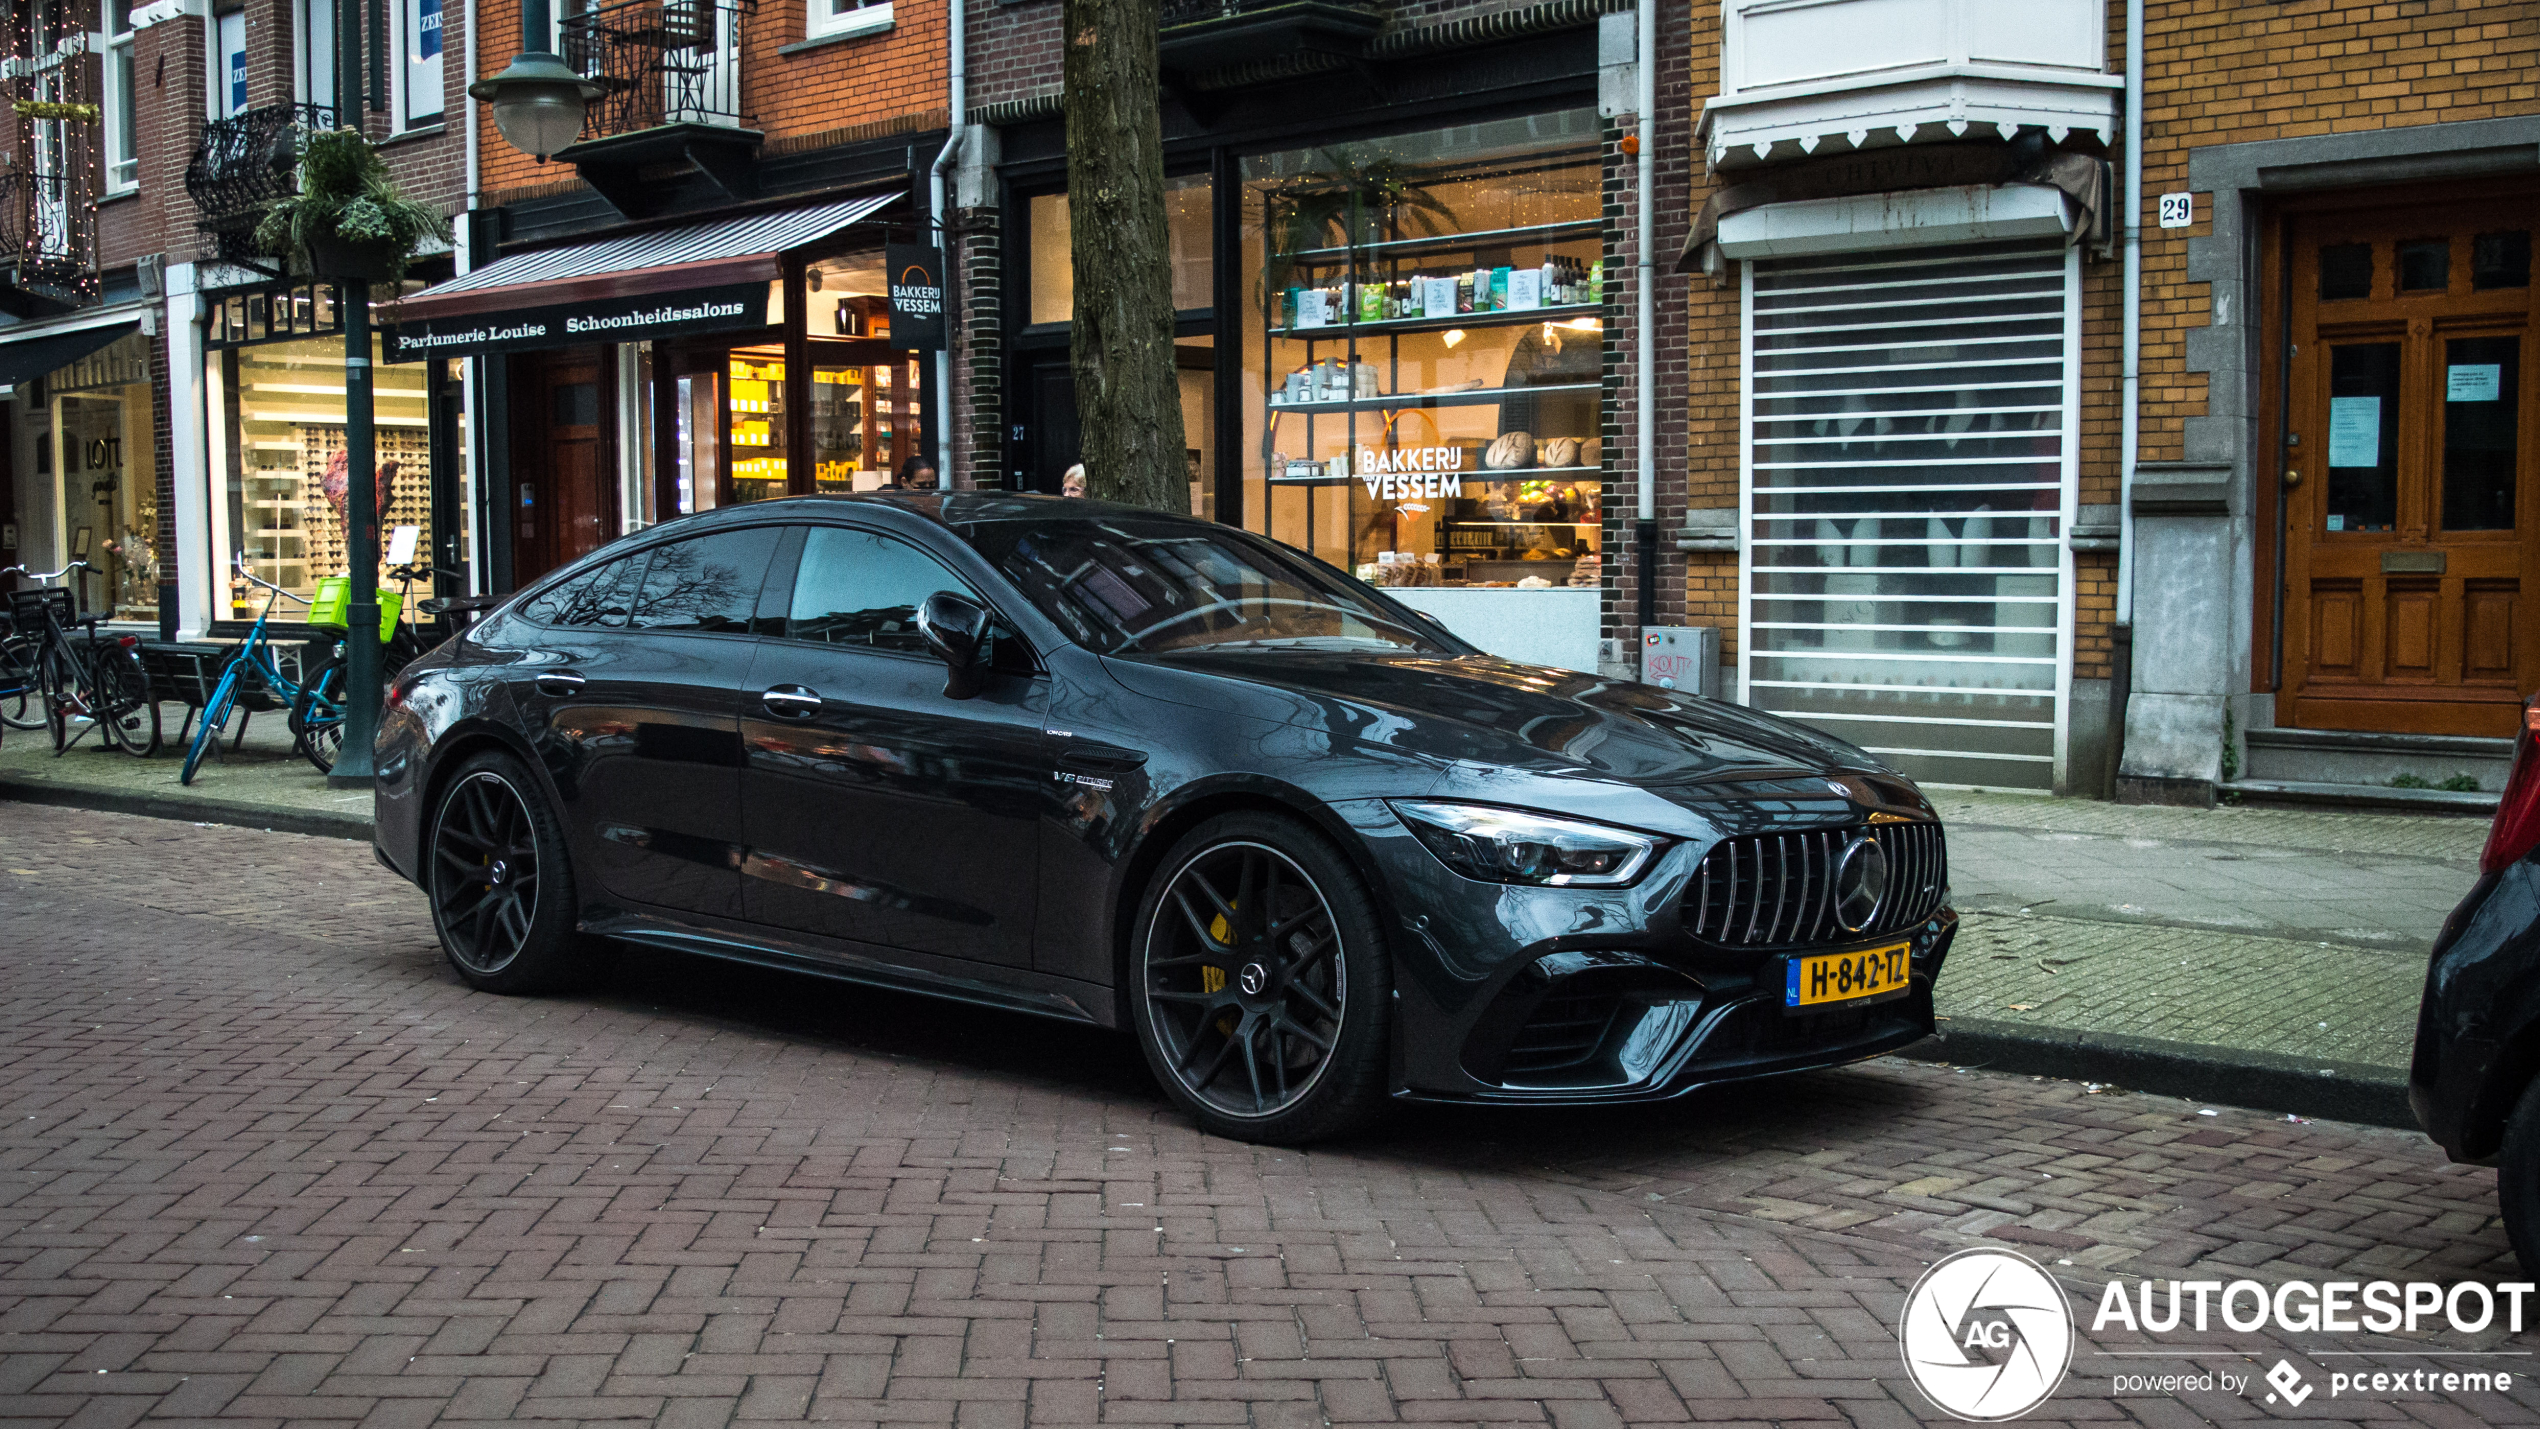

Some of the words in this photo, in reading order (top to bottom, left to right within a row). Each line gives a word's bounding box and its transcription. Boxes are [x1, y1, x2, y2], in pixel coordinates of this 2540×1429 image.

[2163, 198, 2189, 221] 29
[893, 284, 941, 299] BAKKERIJ
[566, 302, 744, 333] Schoonheidssalons
[895, 298, 941, 313] VESSEM
[398, 328, 486, 350] Parfumerie
[488, 323, 546, 341] Louise
[1012, 426, 1025, 441] 27
[1363, 446, 1462, 473] BAKKERIJ
[1366, 472, 1462, 500] VESSEM
[1811, 947, 1905, 997] H-842-TZ
[1787, 987, 1798, 998] NL
